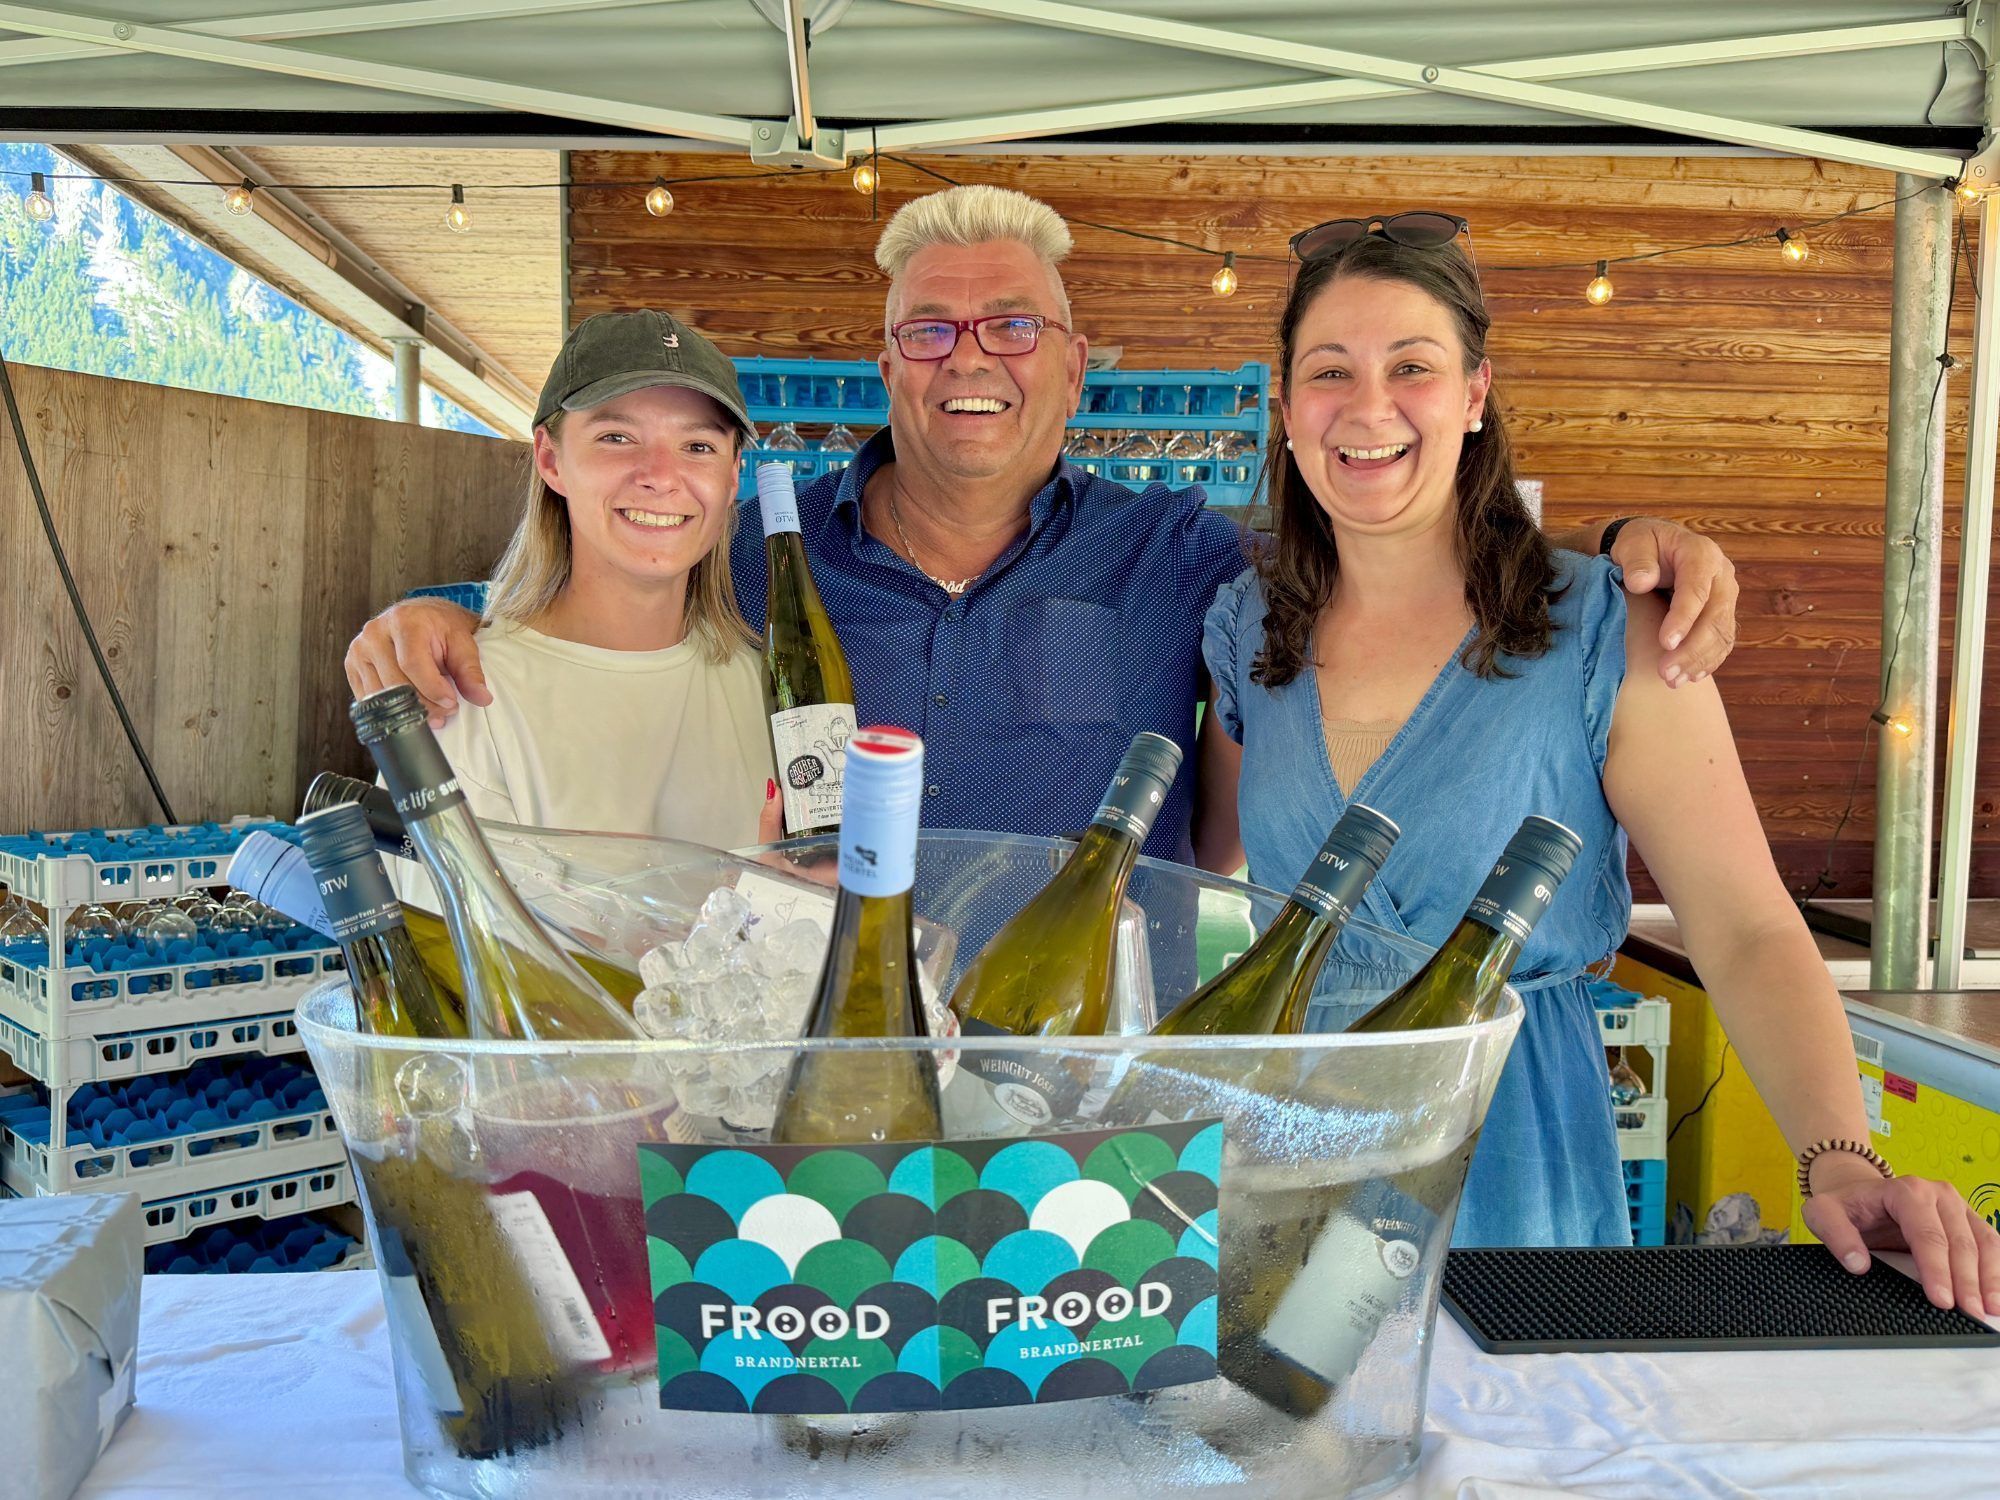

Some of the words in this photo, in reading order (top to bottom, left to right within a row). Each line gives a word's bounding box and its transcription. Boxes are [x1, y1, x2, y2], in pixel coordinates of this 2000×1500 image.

[775, 515, 794, 523] OTW
[789, 758, 818, 778] GRUBER
[409, 787, 436, 811] life
[1319, 851, 1350, 871] OTW
[319, 874, 348, 896] OTW
[980, 1058, 1032, 1080] WEINGUT
[987, 1282, 1173, 1334] FROOD
[701, 1304, 890, 1341] FROOD
[1019, 1334, 1143, 1360] BRANDNERTAL
[734, 1356, 862, 1369] BRANDNERTAL
